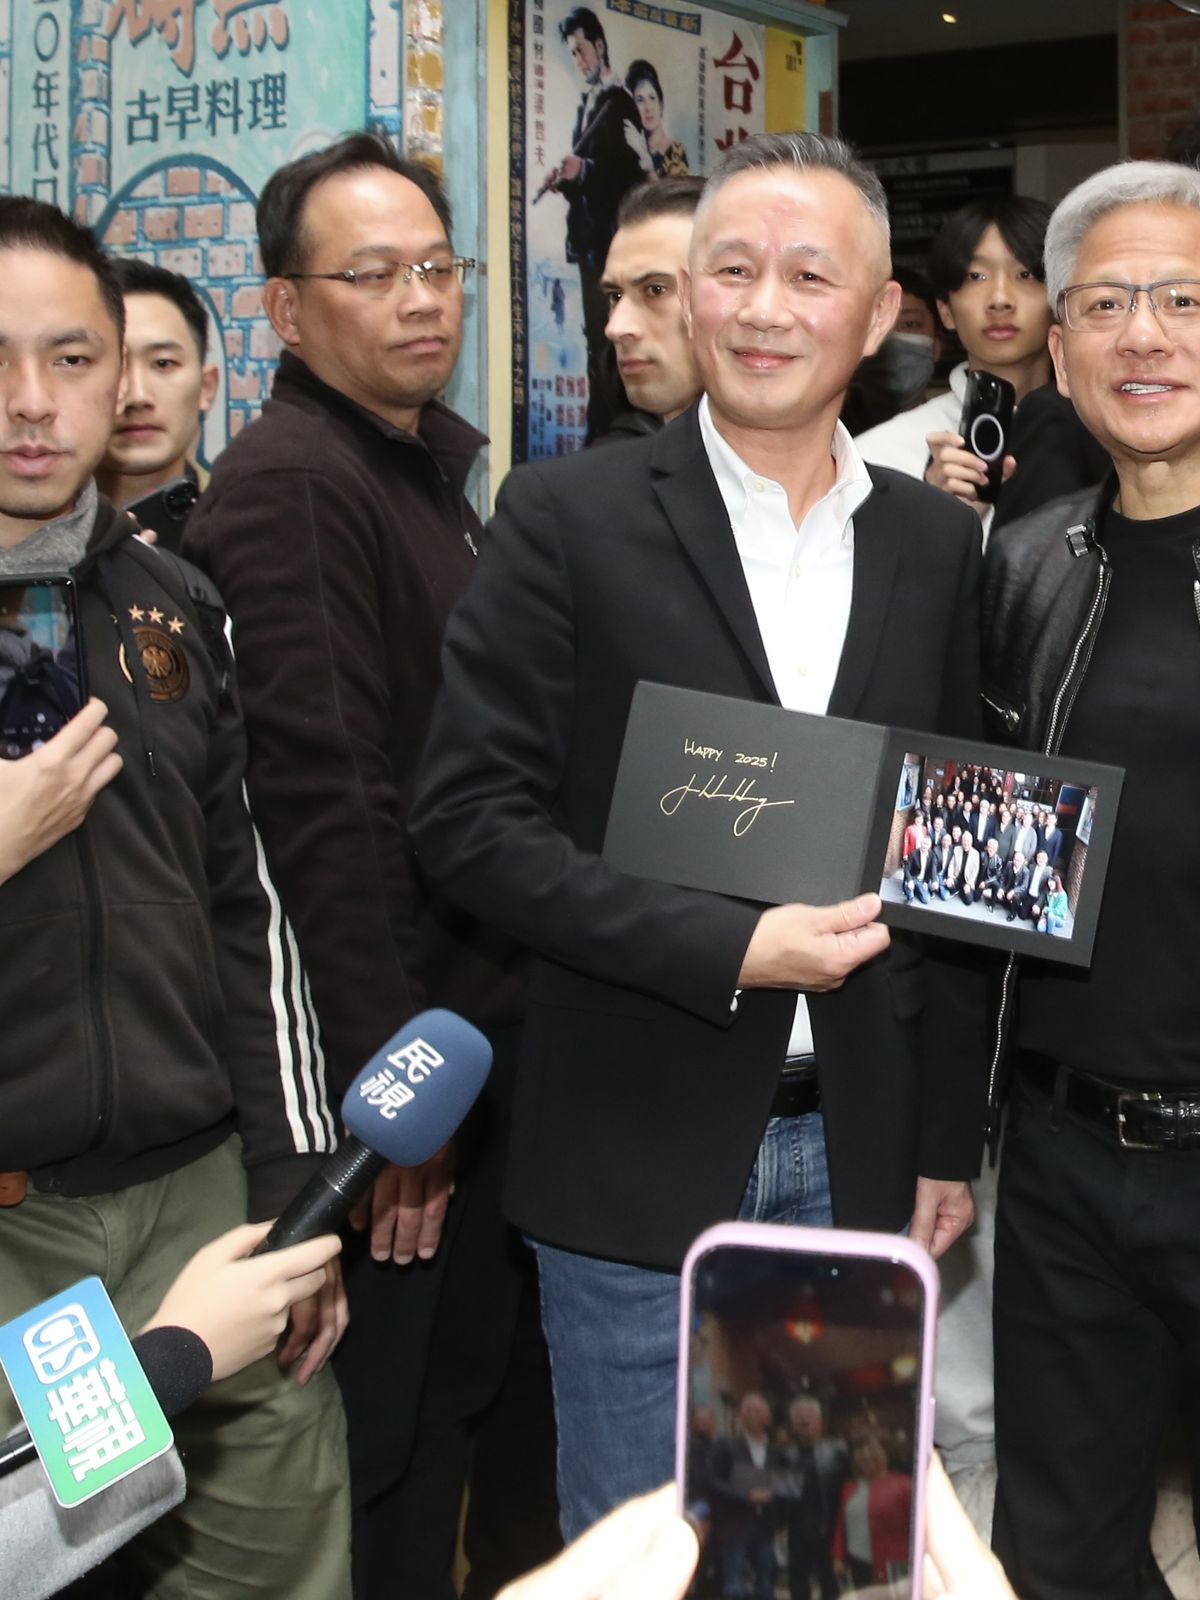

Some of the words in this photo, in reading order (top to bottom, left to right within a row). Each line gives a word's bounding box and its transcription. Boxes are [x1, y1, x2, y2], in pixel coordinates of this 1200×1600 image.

[125, 71, 288, 145] 古早料理
[735, 751, 778, 774] 2025!
[359, 1036, 446, 1121] 民視
[27, 1306, 98, 1380] CTS
[46, 1356, 146, 1484] 華視
